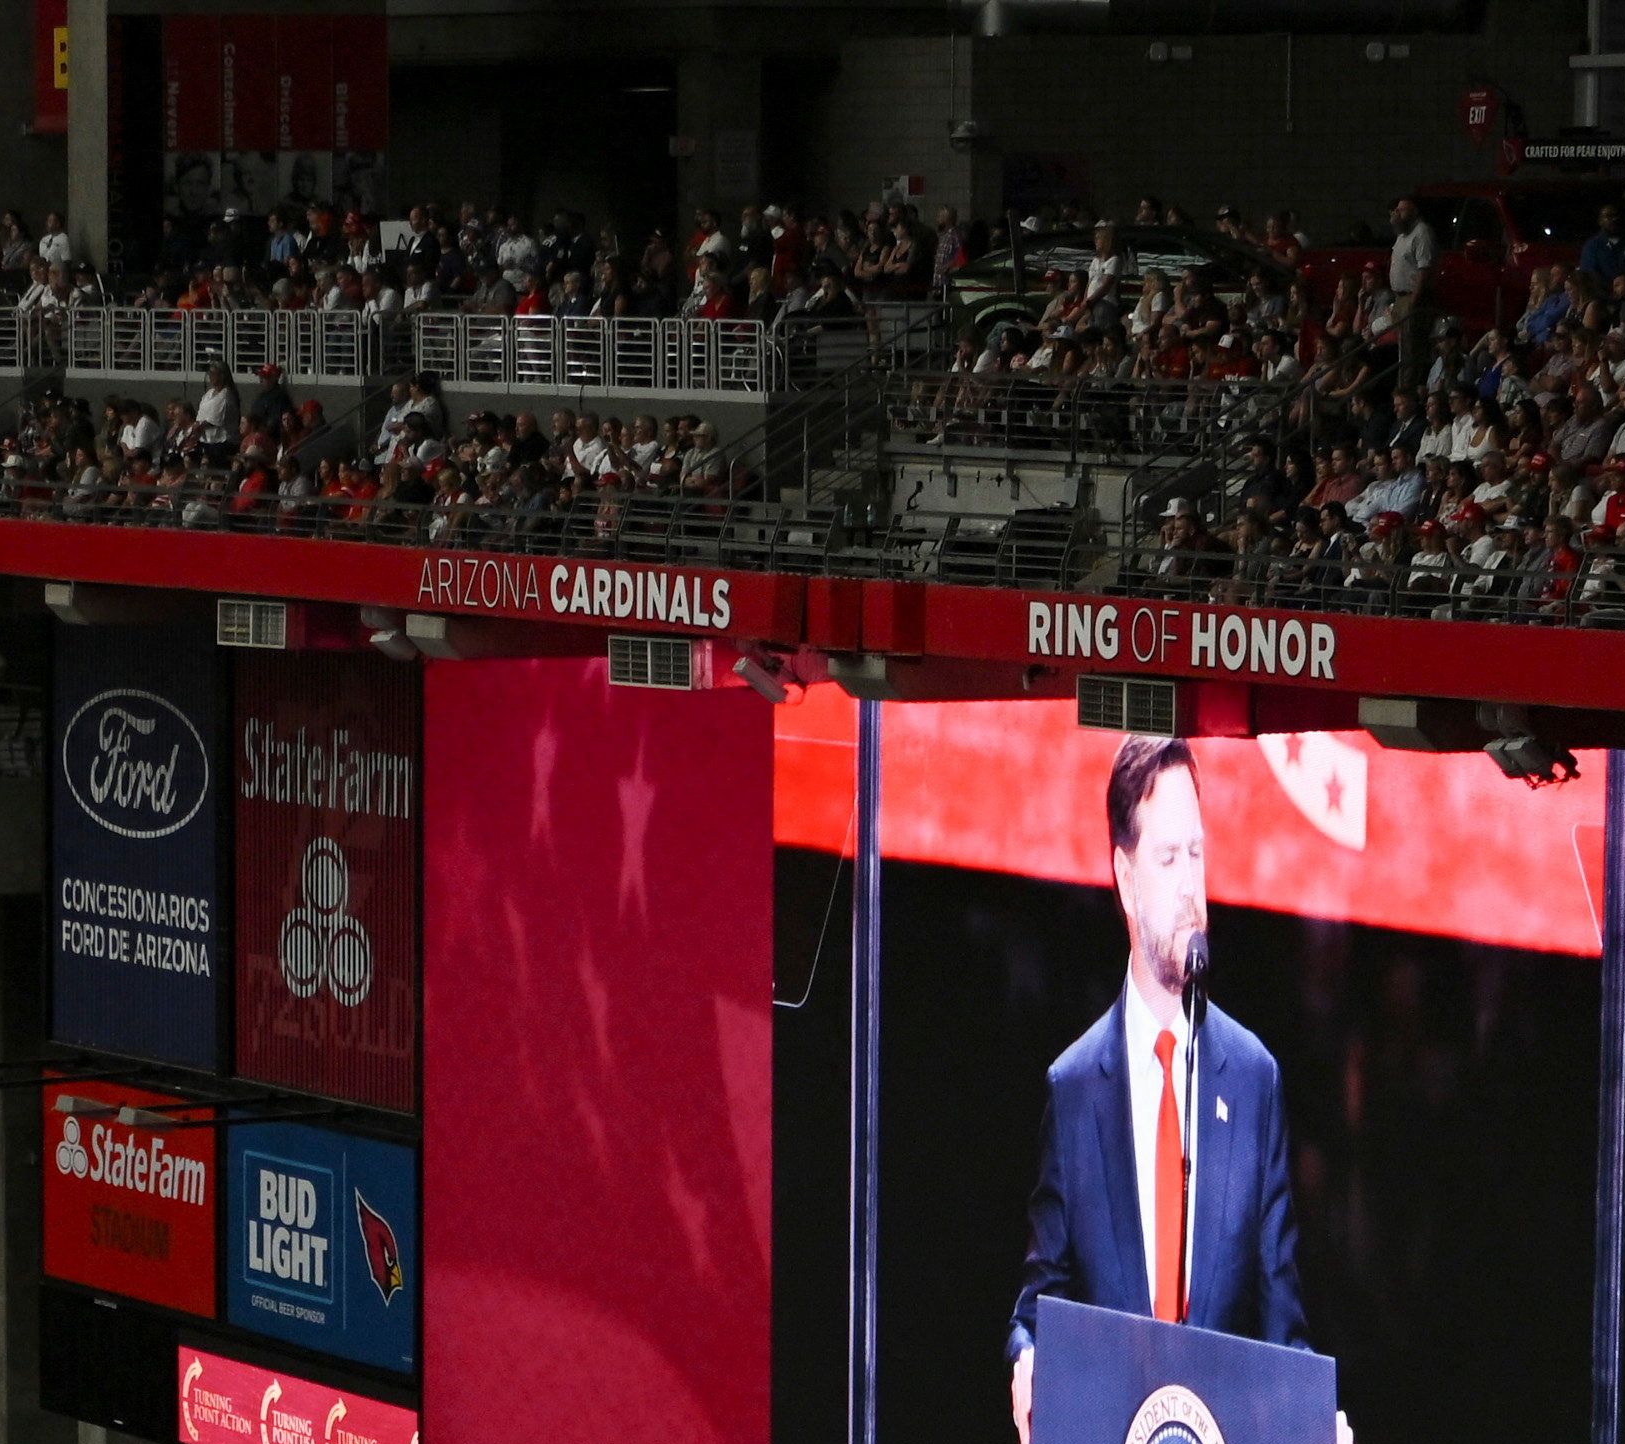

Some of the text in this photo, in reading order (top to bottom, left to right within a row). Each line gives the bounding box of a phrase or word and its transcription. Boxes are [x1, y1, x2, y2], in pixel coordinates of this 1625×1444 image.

[1469, 105, 1487, 125] EXIT
[1525, 146, 1558, 158] CRAFTED
[1559, 146, 1575, 158] FOR
[1576, 145, 1596, 158] PEAK
[417, 557, 731, 630] ARIZONA CARDINALS
[1028, 601, 1336, 680] RING OF HONOR
[90, 706, 180, 815] Ford
[62, 877, 211, 933] CONCESIONARIOS
[62, 919, 211, 978] FORD DE ARIZONA
[259, 1168, 317, 1230] BUD
[248, 1219, 328, 1287] LIGHT
[251, 1295, 326, 1325] OFFICIAL BEER SPONSOR
[193, 1388, 232, 1413] TURNING
[193, 1401, 251, 1435] POINT ACTION
[272, 1410, 312, 1437] TURNING
[1194, 1414, 1209, 1439] THE
